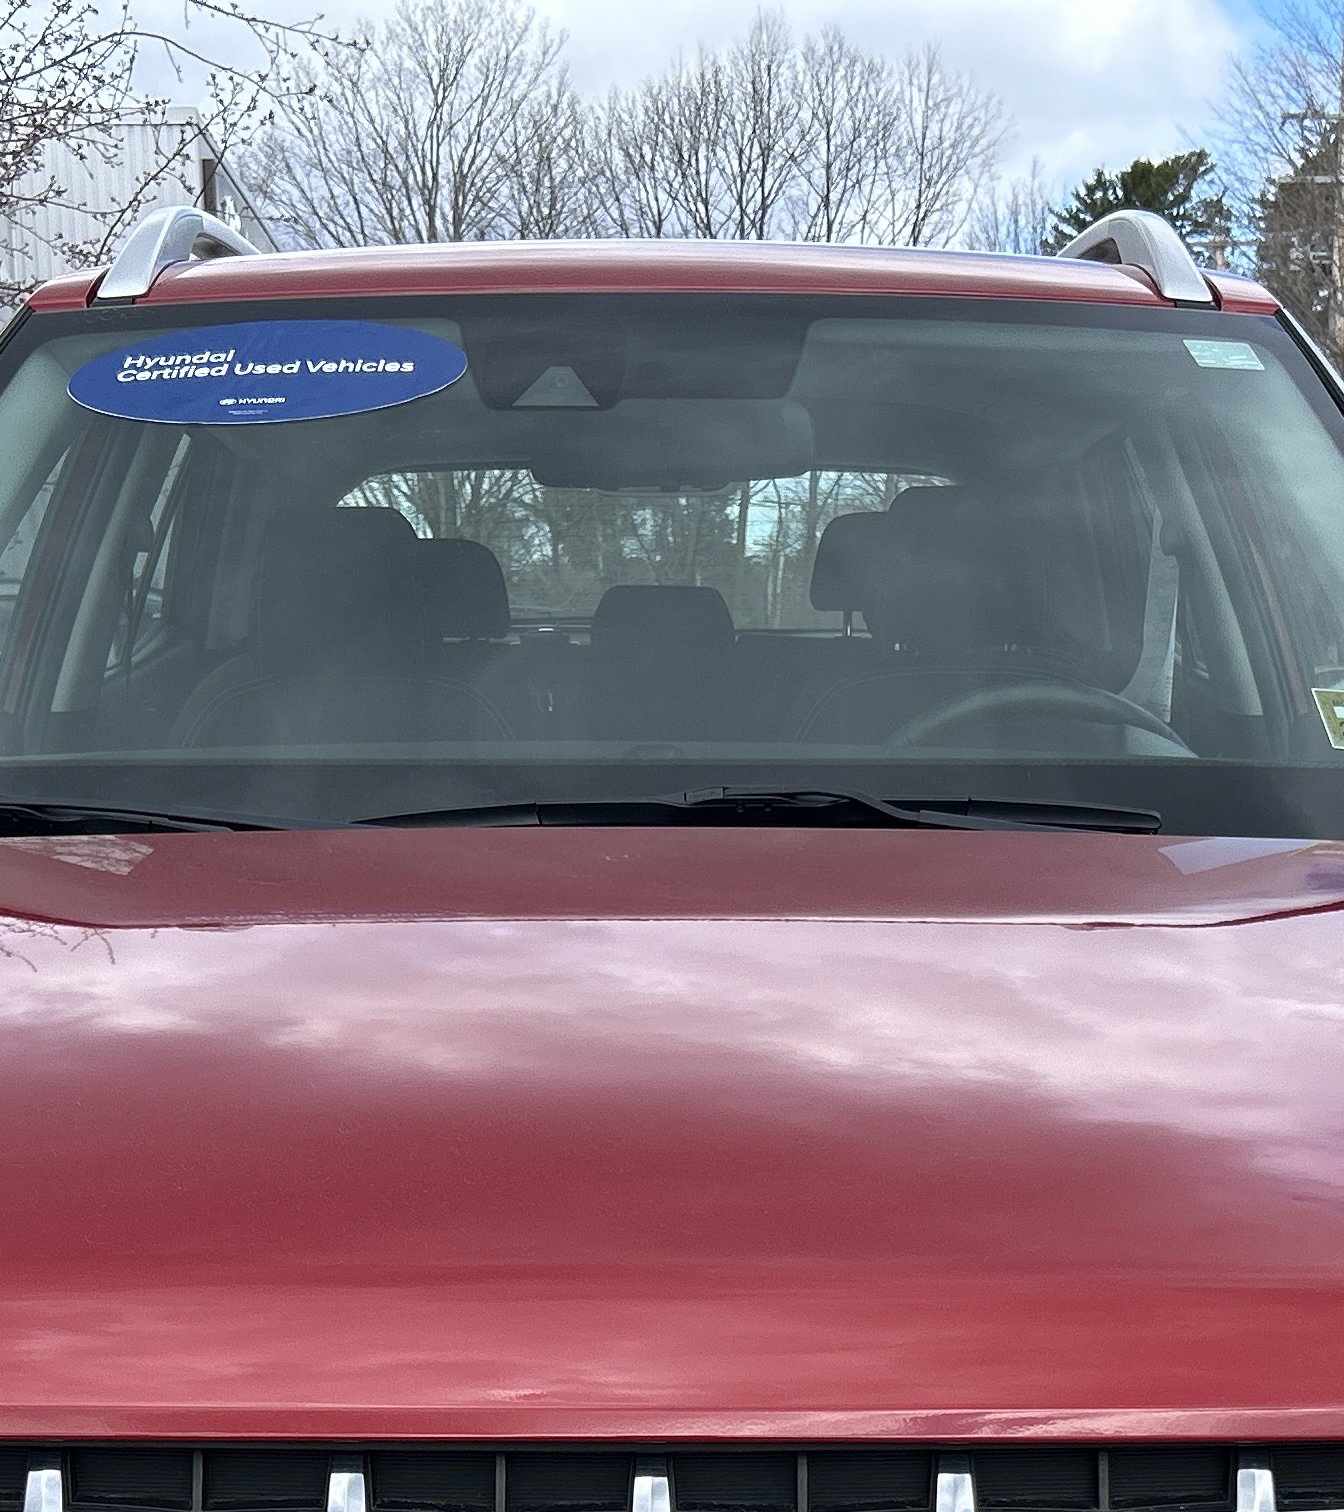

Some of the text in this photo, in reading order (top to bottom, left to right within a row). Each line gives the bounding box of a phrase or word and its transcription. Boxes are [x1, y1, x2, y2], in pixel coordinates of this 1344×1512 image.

[123, 349, 235, 369] Hyundai
[117, 359, 415, 382] Certified Used Vehicles
